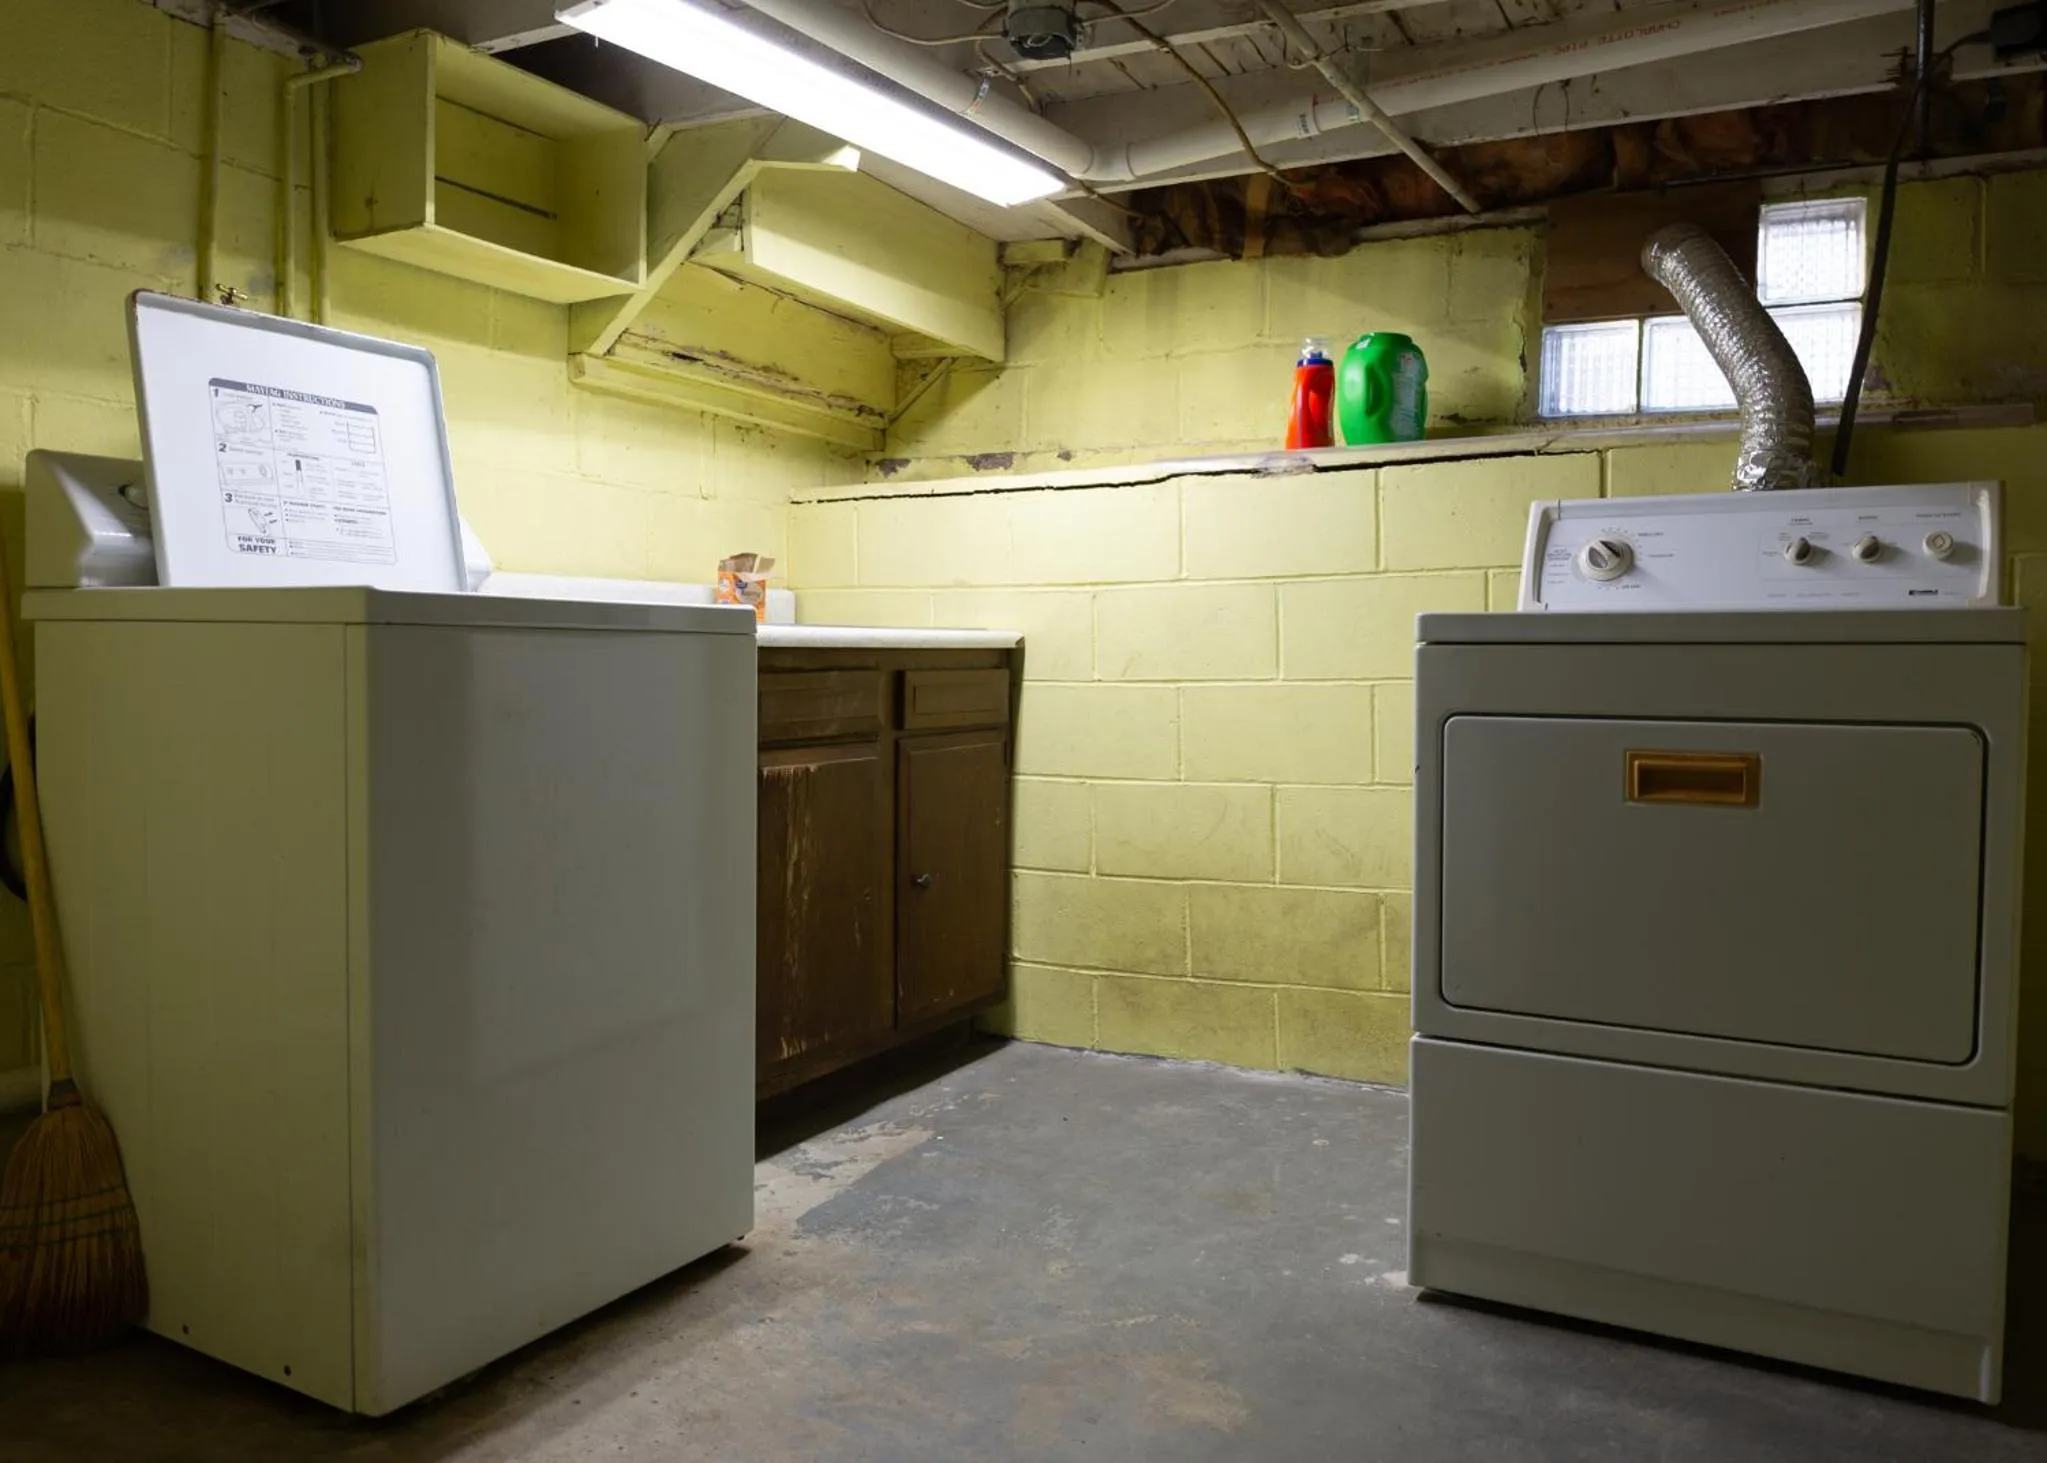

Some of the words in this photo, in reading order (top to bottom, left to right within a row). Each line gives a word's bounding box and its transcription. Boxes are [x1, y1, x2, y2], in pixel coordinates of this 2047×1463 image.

[212, 388, 219, 398] 1
[218, 443, 227, 453] 2
[224, 493, 233, 503] 3
[237, 535, 253, 543] FOR
[255, 536, 276, 544] YOUR
[238, 544, 277, 554] SAFETY
